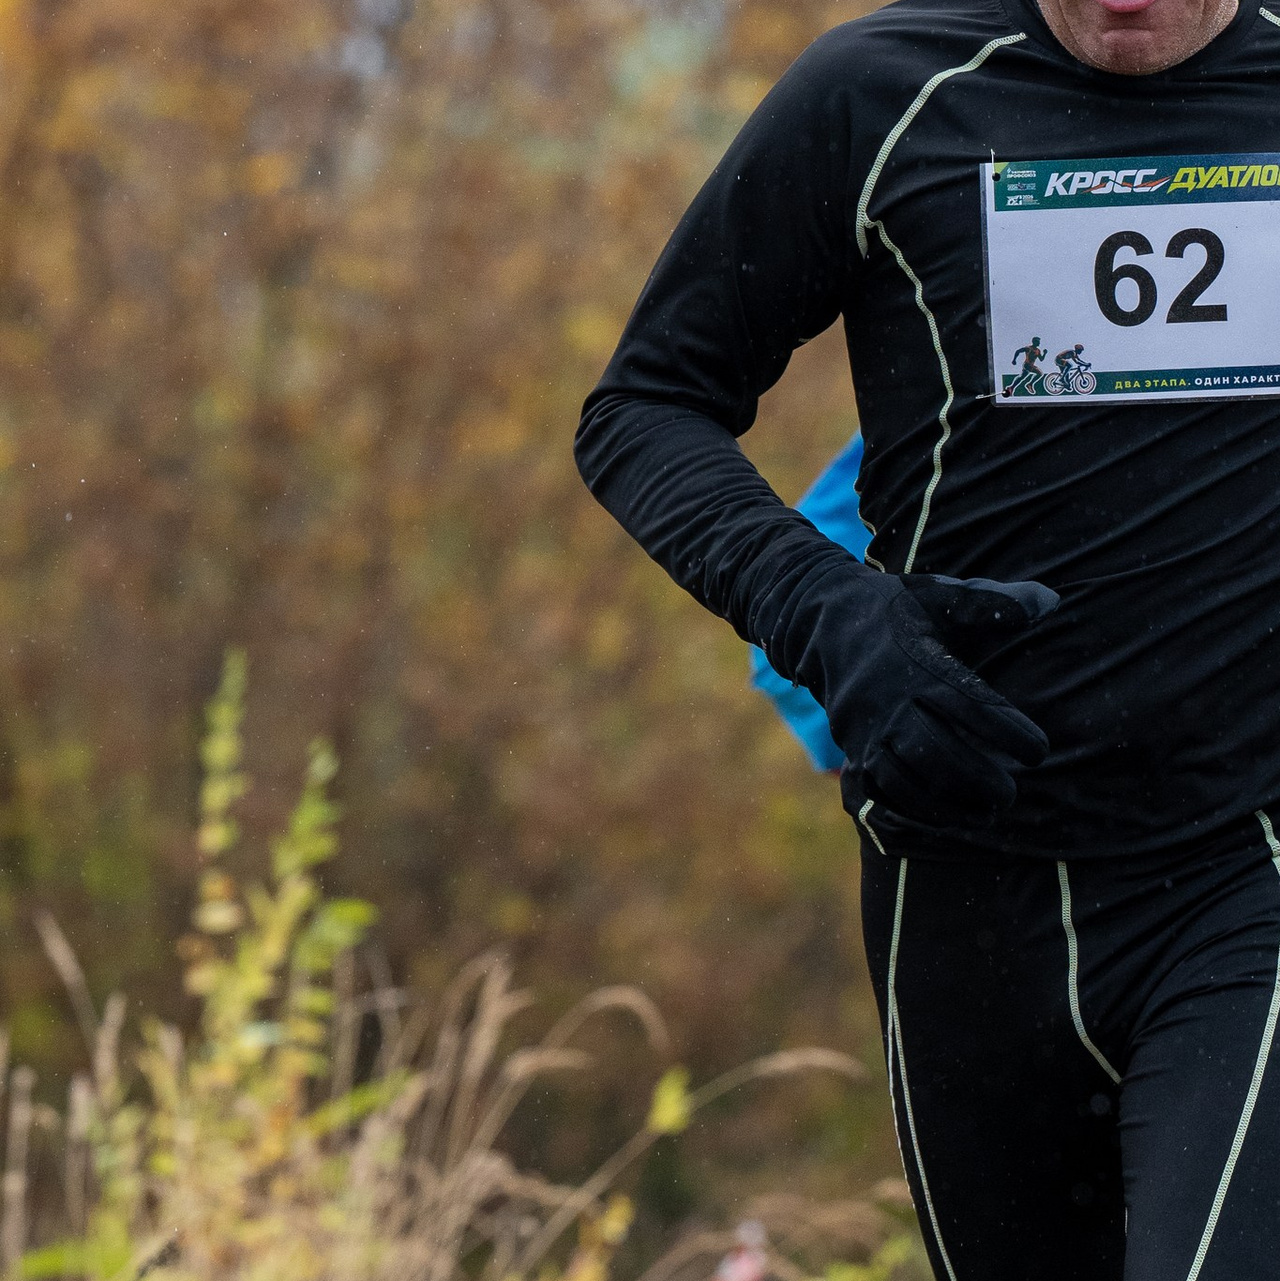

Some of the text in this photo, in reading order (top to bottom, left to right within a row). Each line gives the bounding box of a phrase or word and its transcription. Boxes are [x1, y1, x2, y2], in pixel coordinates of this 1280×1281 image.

[1044, 168, 1170, 197] КРОСС
[1094, 227, 1228, 327] 62
[1114, 380, 1141, 390] ДВА
[1145, 378, 1192, 388] ЭТАПА.
[1195, 376, 1230, 387] ОДИН
